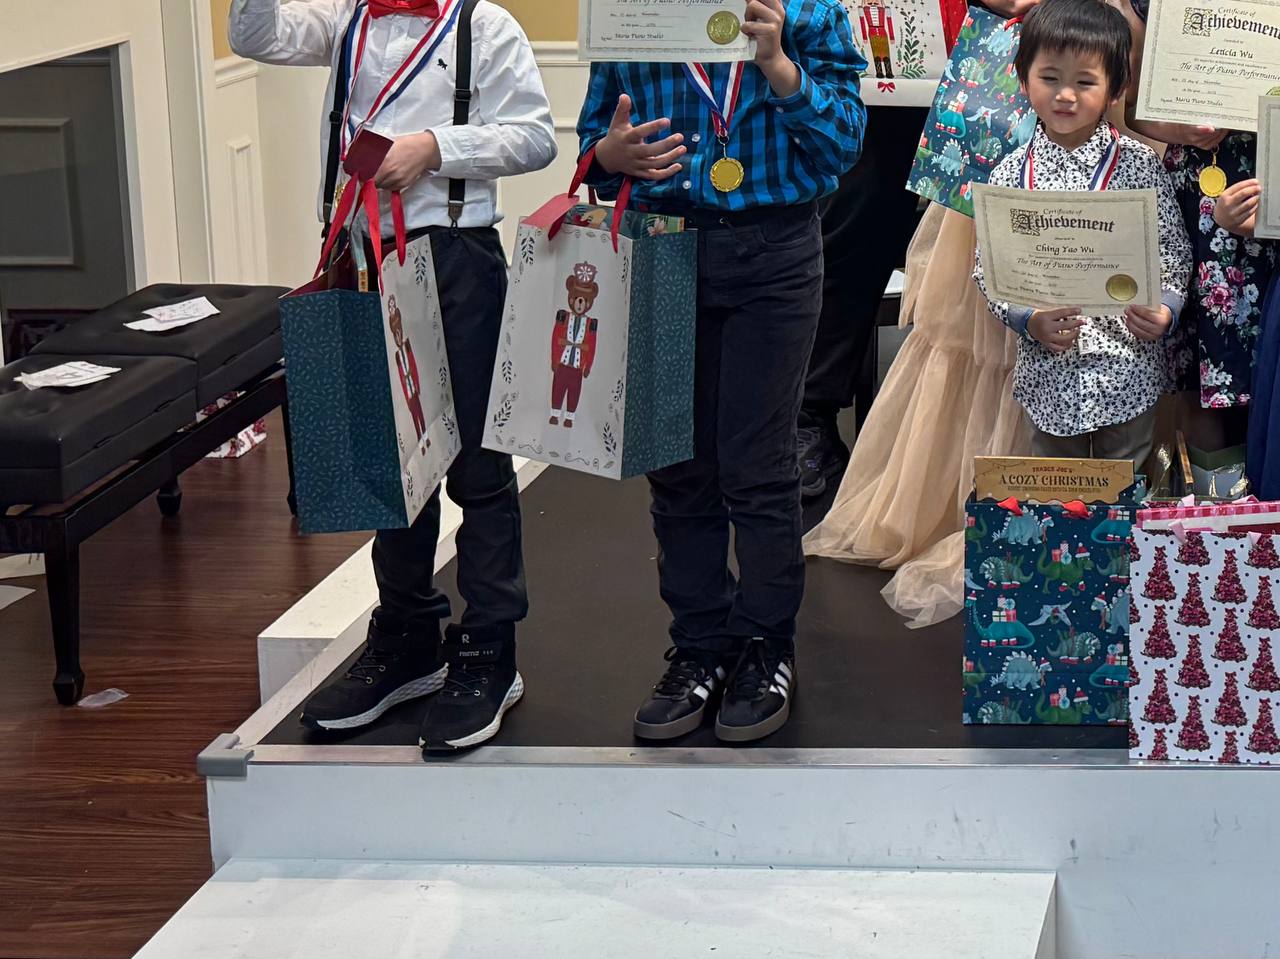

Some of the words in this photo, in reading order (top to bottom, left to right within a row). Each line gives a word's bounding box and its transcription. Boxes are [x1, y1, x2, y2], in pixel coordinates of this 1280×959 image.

[1218, 6, 1248, 16] Certificate
[1249, 10, 1256, 18] of
[1209, 46, 1237, 57] Leticia
[1240, 49, 1254, 59] Wu
[1179, 62, 1192, 71] The
[1206, 65, 1215, 75] of
[1215, 65, 1237, 75] Piano
[1016, 213, 1115, 233] Achievement
[1035, 243, 1060, 256] Ching
[1062, 245, 1078, 253] Yao
[1080, 245, 1095, 253] Wu
[1043, 261, 1051, 270] of
[1075, 261, 1120, 272] Performance
[1000, 473, 1007, 485] A
[1008, 473, 1039, 485] COZY
[1040, 474, 1109, 487] CHRISTMAS
